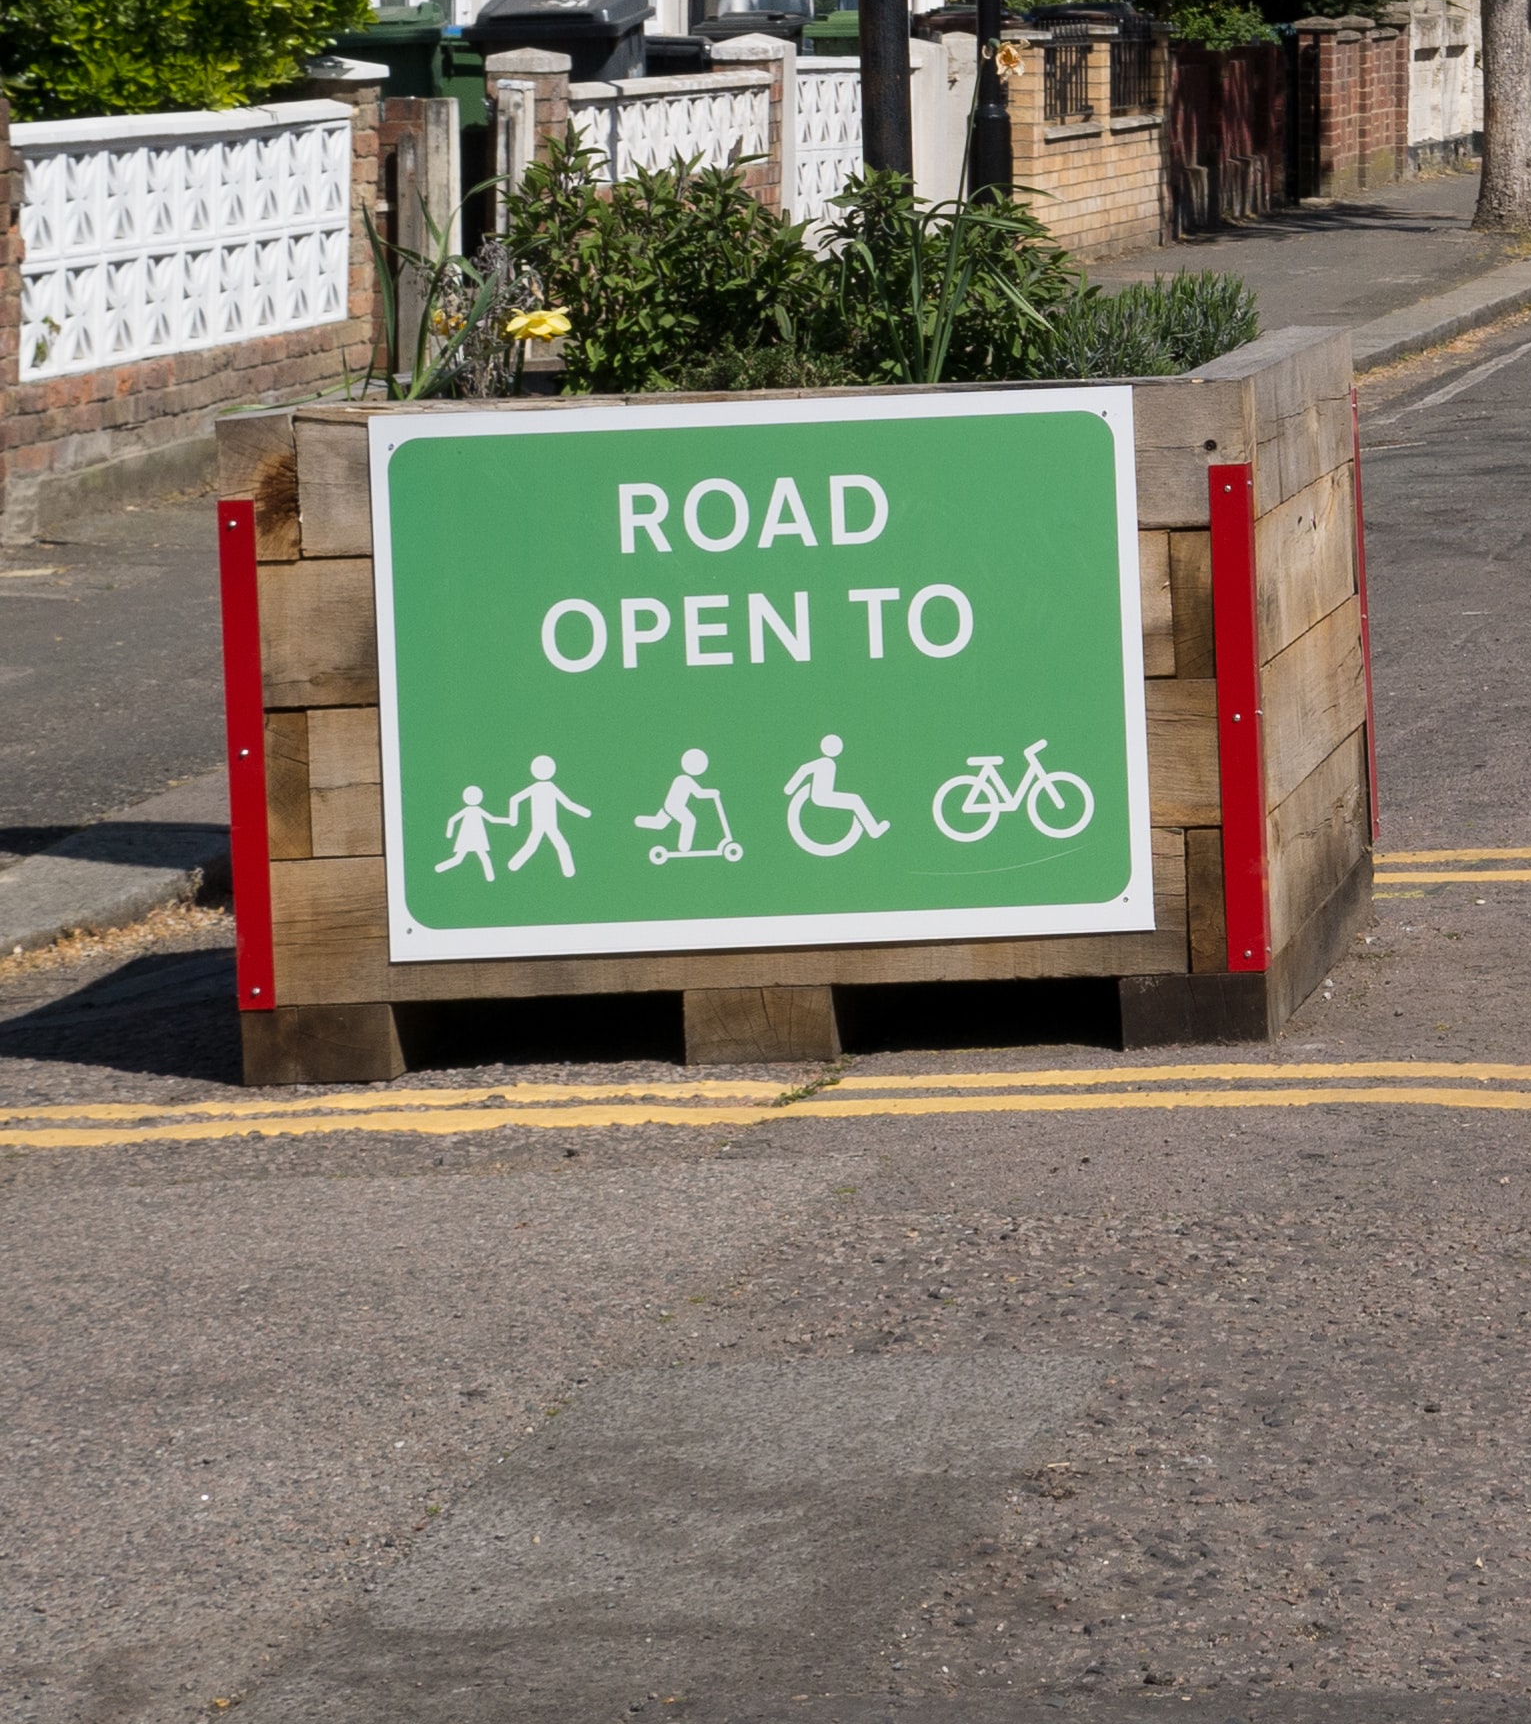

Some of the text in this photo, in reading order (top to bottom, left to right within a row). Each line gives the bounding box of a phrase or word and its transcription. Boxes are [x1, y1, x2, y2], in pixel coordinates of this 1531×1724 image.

[617, 474, 889, 555] ROAD
[540, 583, 974, 673] OPEN TO
